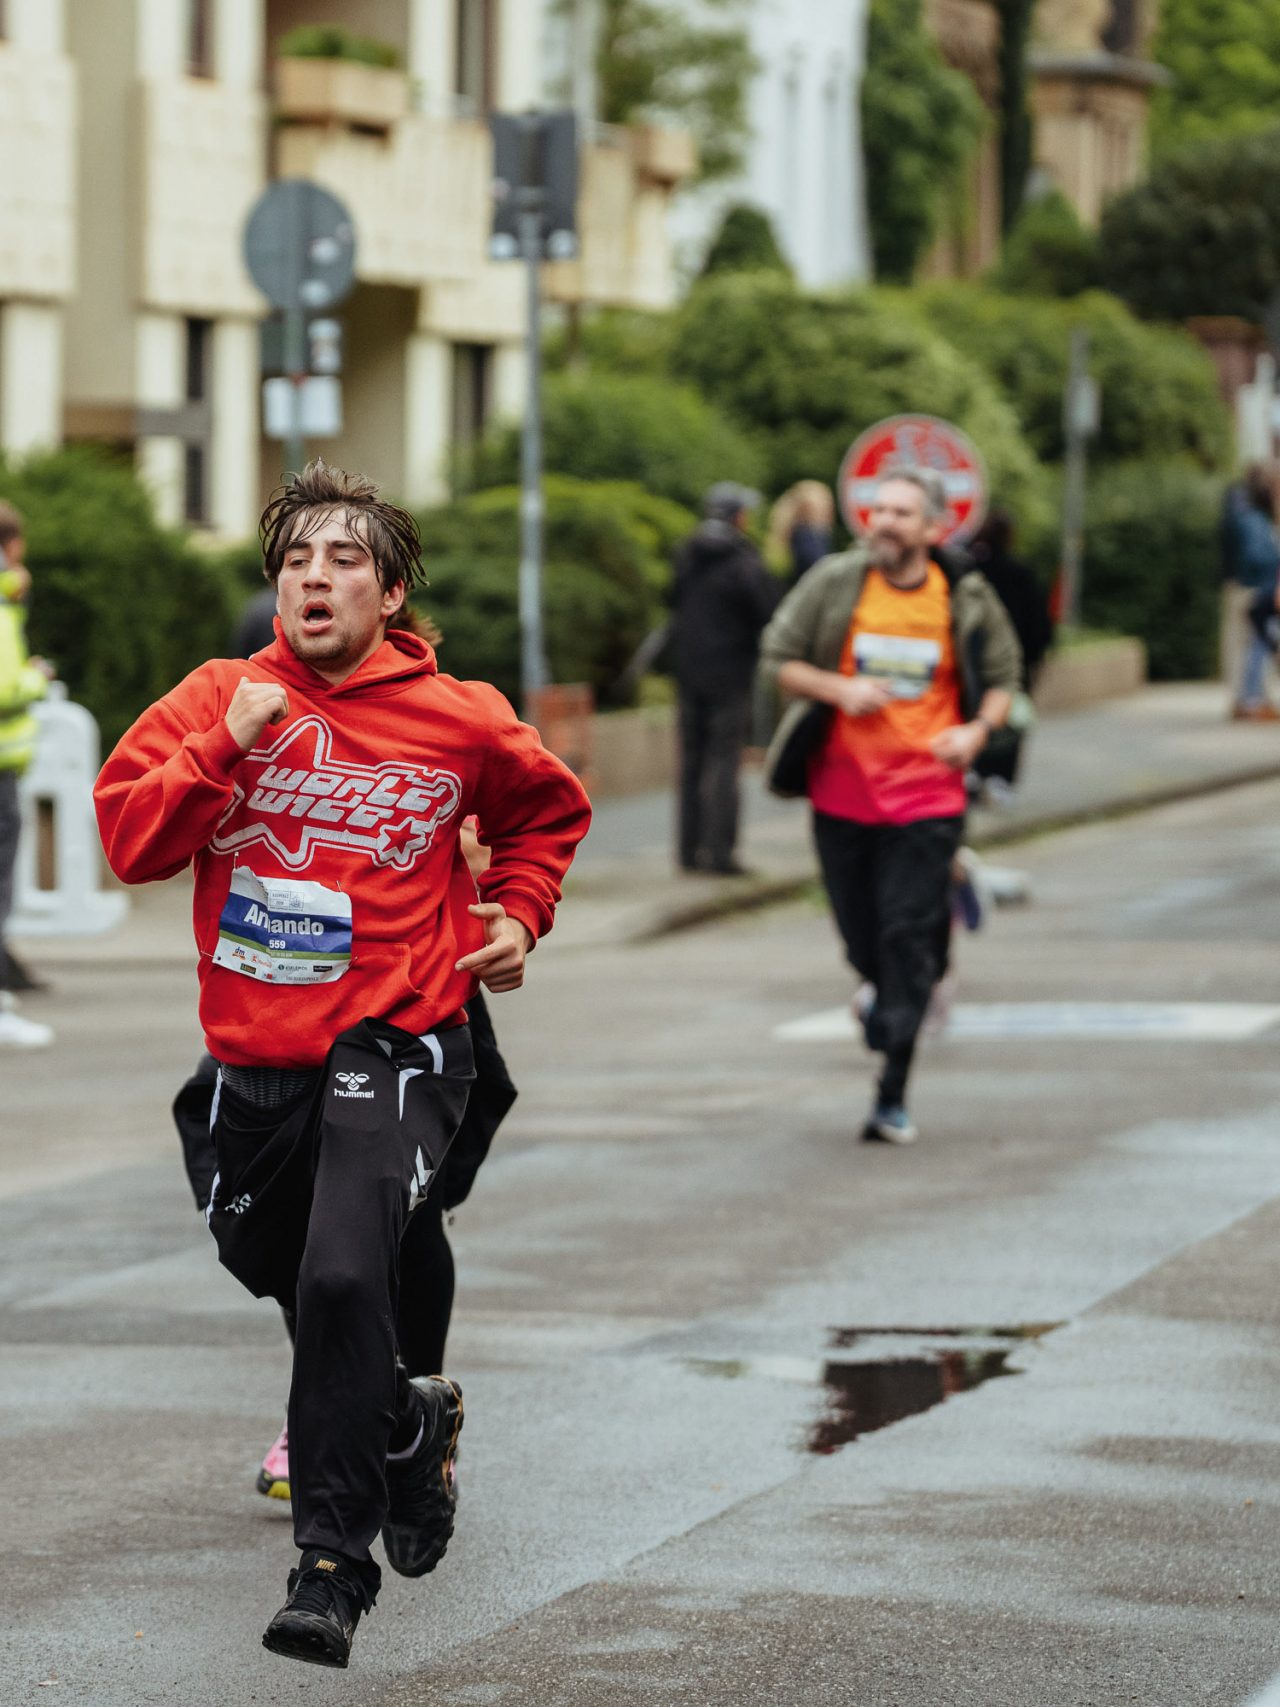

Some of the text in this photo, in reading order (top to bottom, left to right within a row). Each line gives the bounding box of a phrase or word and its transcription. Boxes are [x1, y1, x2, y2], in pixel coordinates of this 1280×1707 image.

[268, 939, 287, 950] 559
[333, 1087, 375, 1099] hummel
[314, 1558, 338, 1573] NIKE
